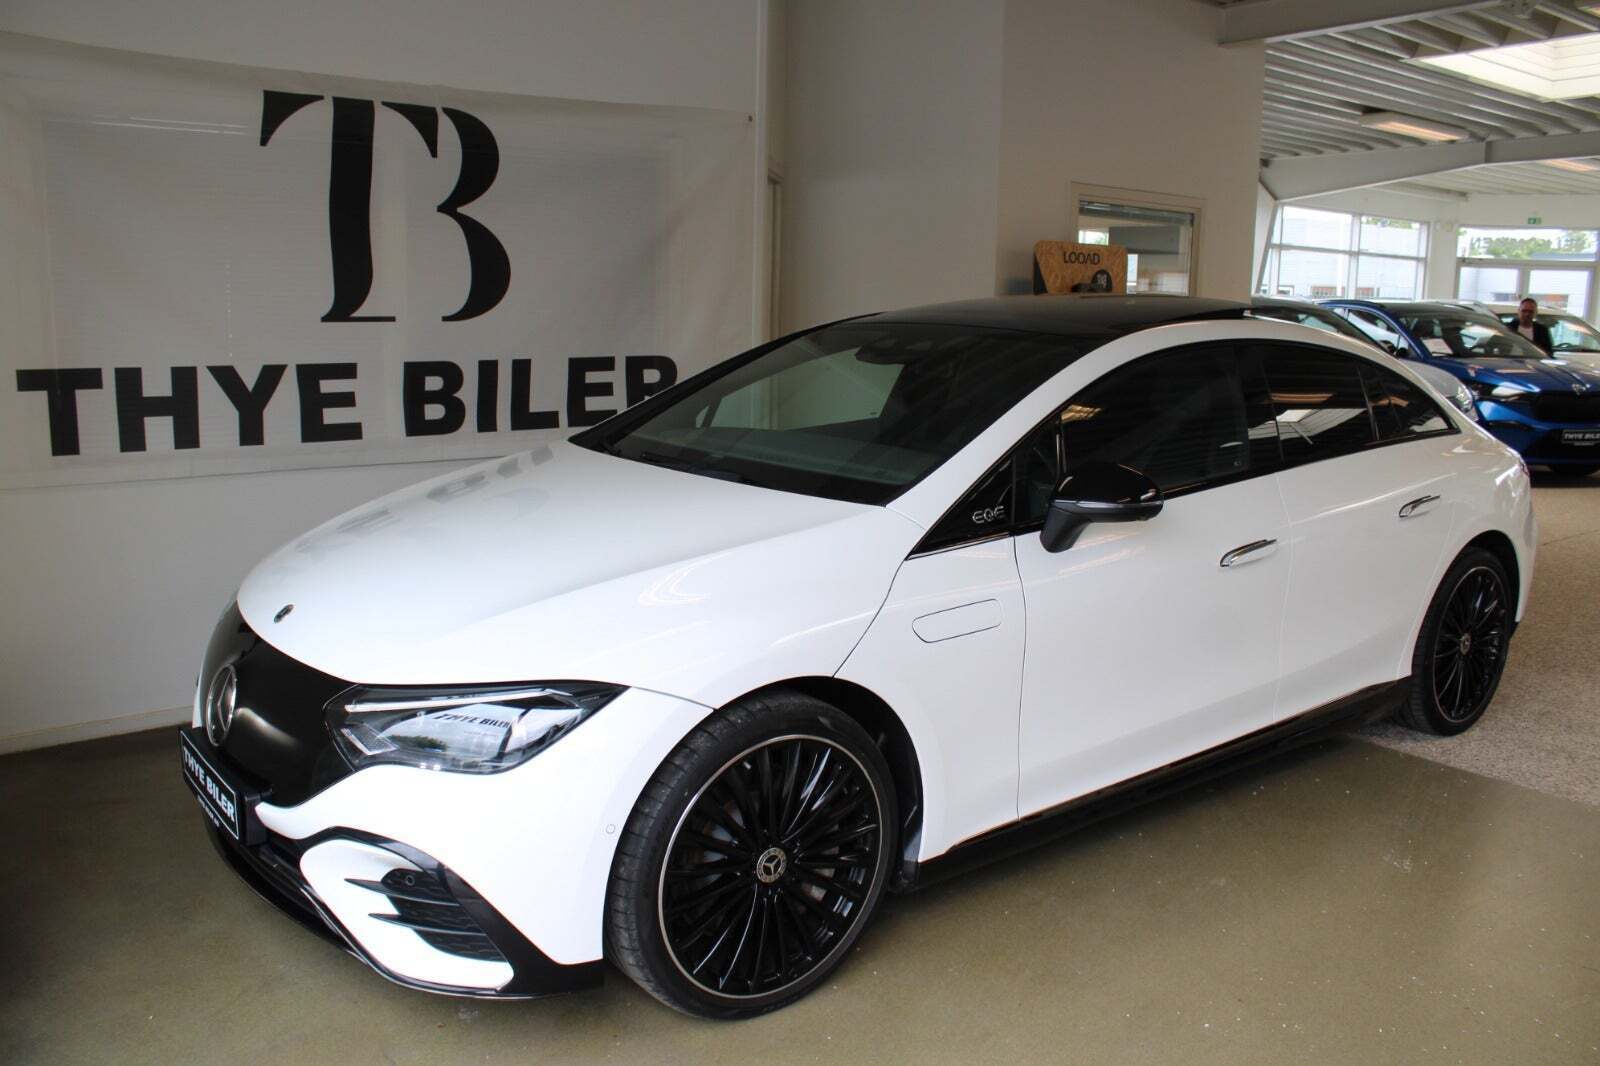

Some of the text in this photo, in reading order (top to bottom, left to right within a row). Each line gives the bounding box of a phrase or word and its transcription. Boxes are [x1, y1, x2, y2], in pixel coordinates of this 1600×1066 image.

[16, 362, 363, 457] THYE
[972, 505, 1005, 524] EQE
[183, 746, 205, 785] THYE
[206, 775, 235, 822] BILER
